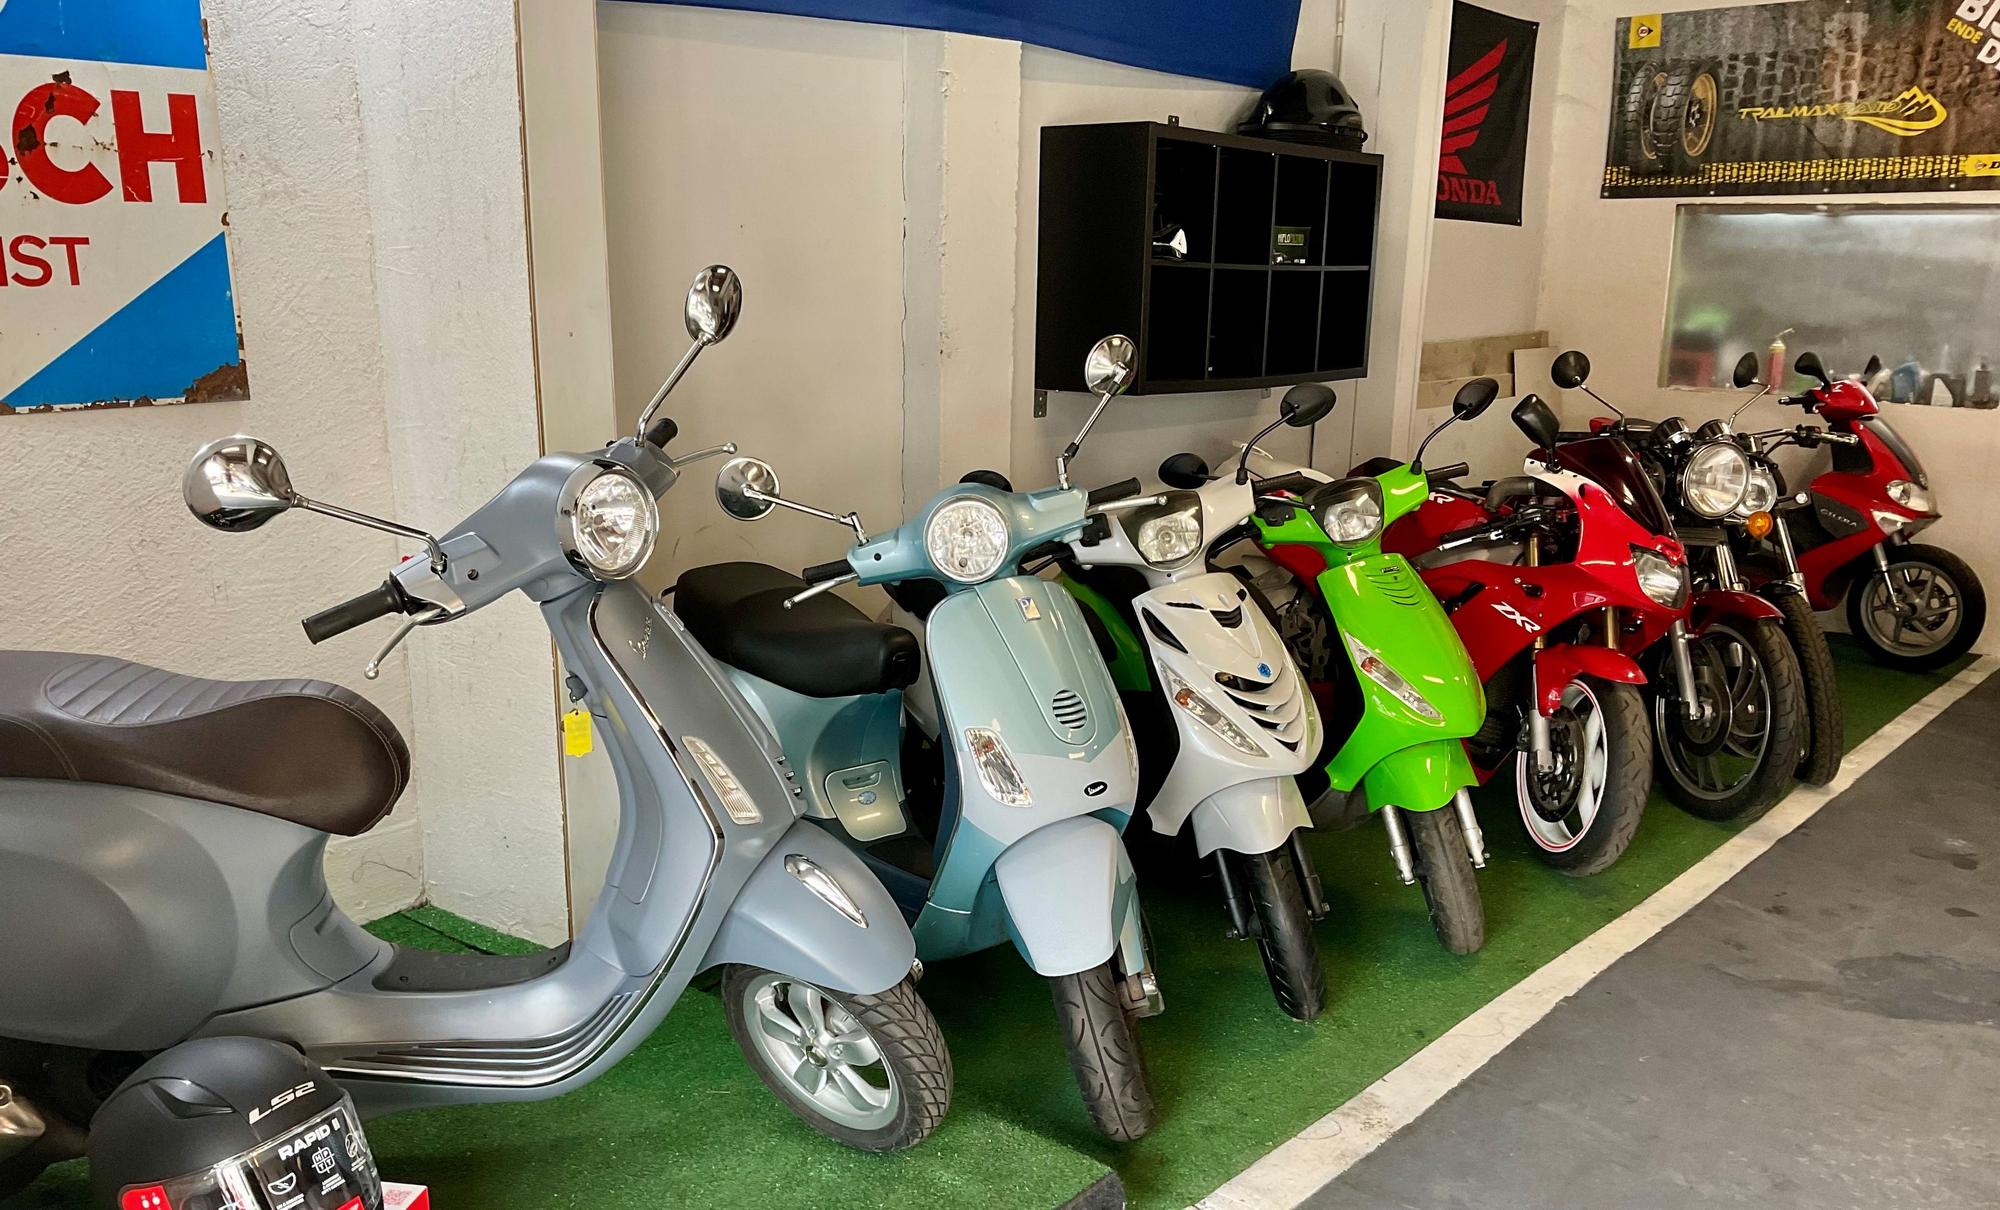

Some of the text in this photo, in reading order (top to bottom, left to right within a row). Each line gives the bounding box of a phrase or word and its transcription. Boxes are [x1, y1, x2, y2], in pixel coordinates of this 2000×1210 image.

[1946, 17, 1983, 44] ENDE
[1955, 0, 2000, 39] BI
[1976, 38, 2000, 71] D
[1738, 102, 1837, 125] TRAILMAX
[0, 82, 207, 205] CH
[1490, 601, 1541, 634] ZXR
[249, 1081, 317, 1125] LS2
[278, 1117, 341, 1161] RAPID I
